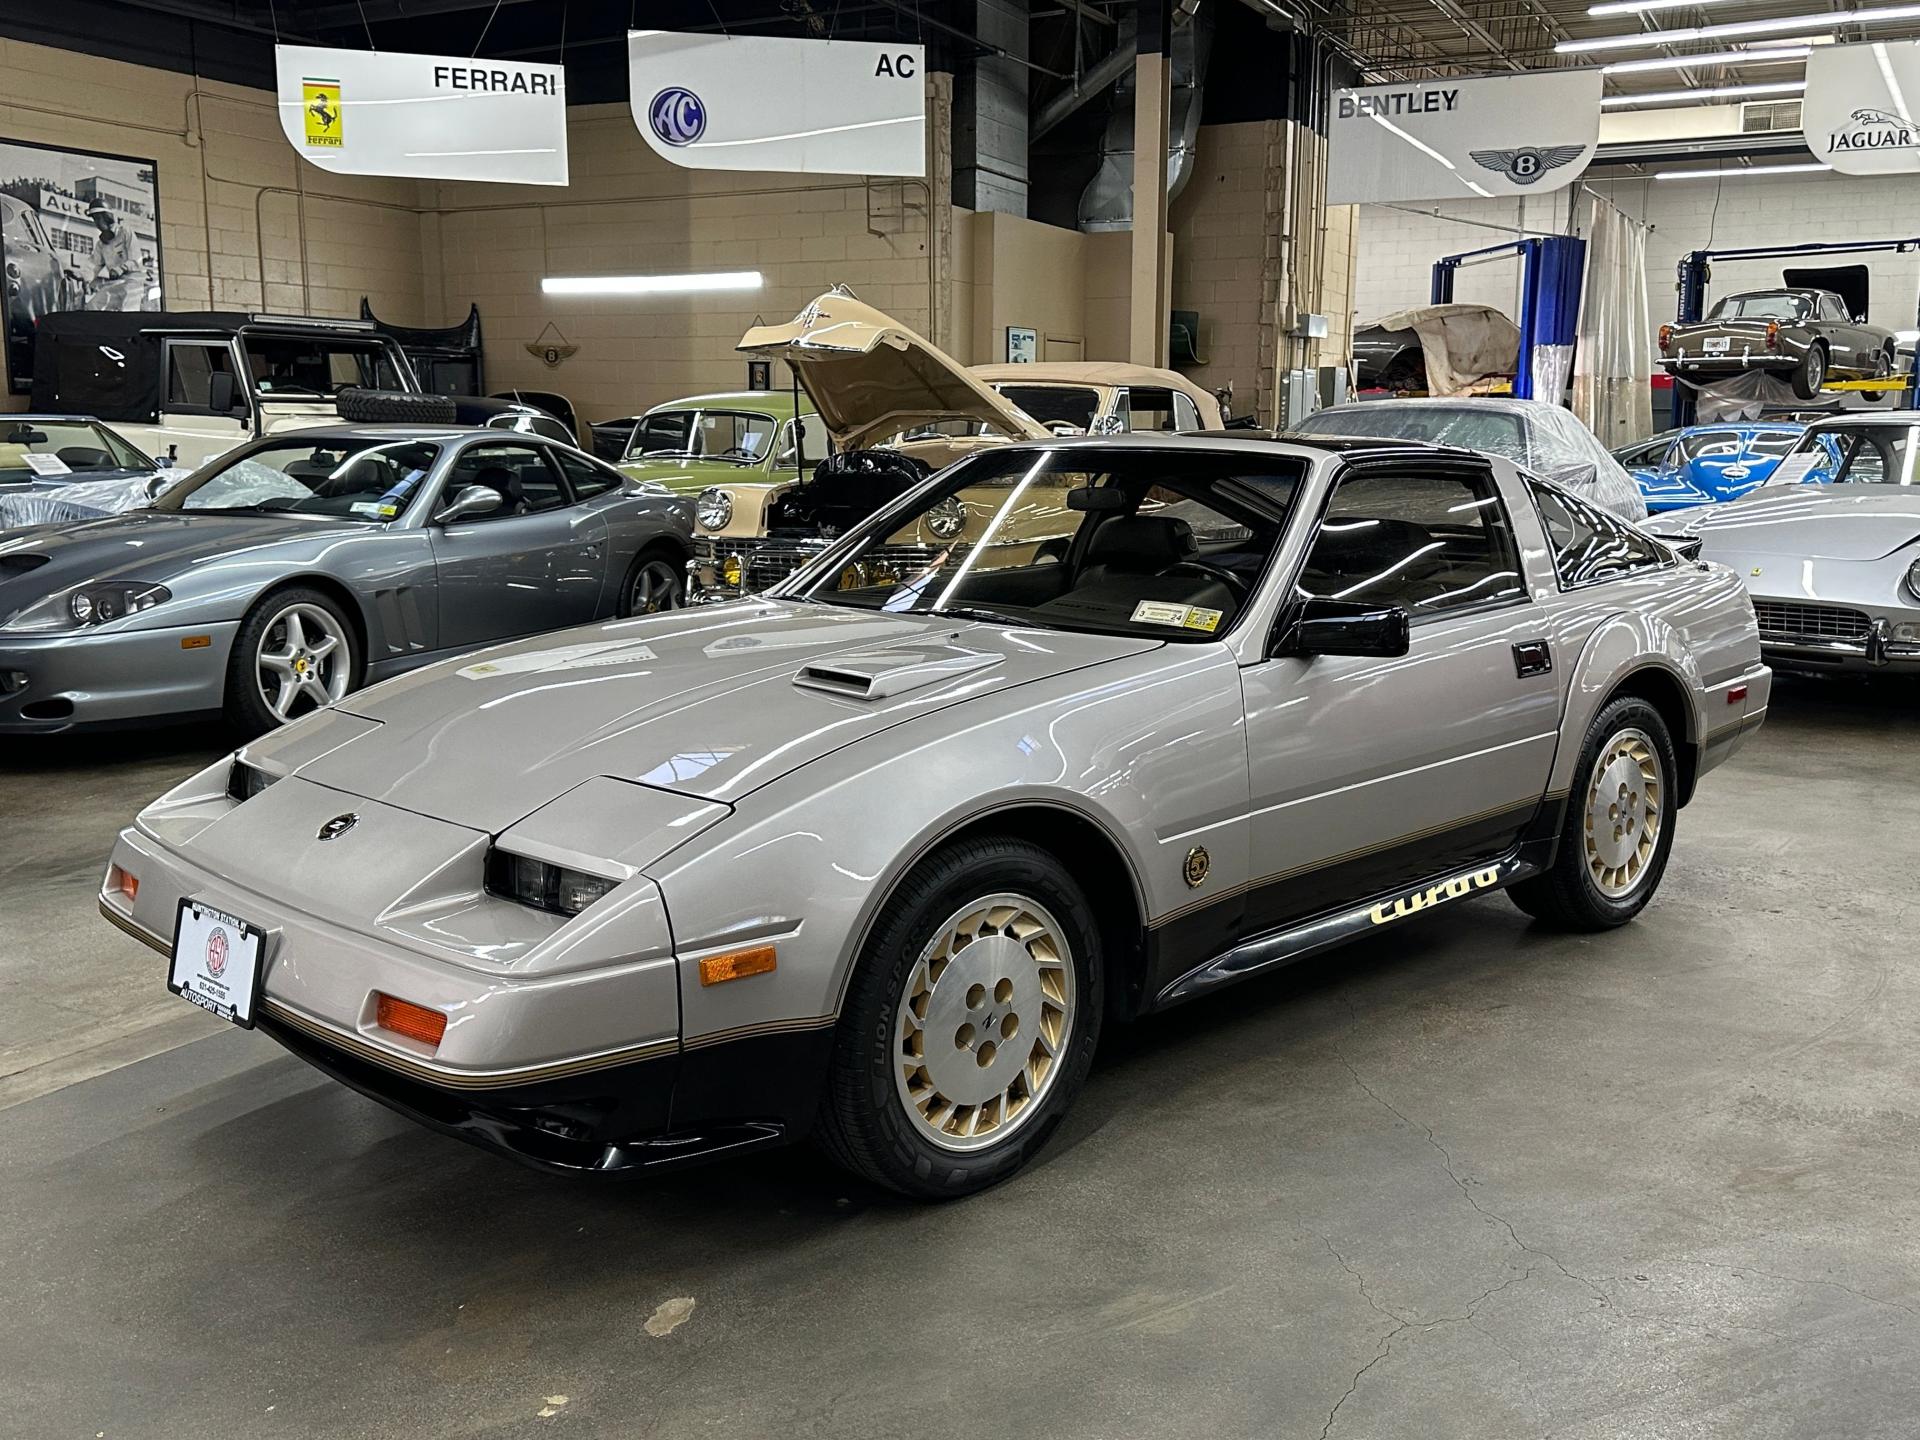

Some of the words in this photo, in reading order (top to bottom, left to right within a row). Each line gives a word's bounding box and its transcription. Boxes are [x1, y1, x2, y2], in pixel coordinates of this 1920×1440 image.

[434, 66, 557, 96] FERRARI
[874, 53, 915, 79] AC
[653, 92, 699, 141] AC
[1338, 89, 1459, 119] BENTLEY
[307, 135, 342, 146] Ferrari
[1827, 129, 1911, 154] JAGUAR
[1679, 283, 1687, 316] ROTARY
[180, 988, 219, 1013] AUTOSPORT
[873, 1002, 891, 1065] LION
